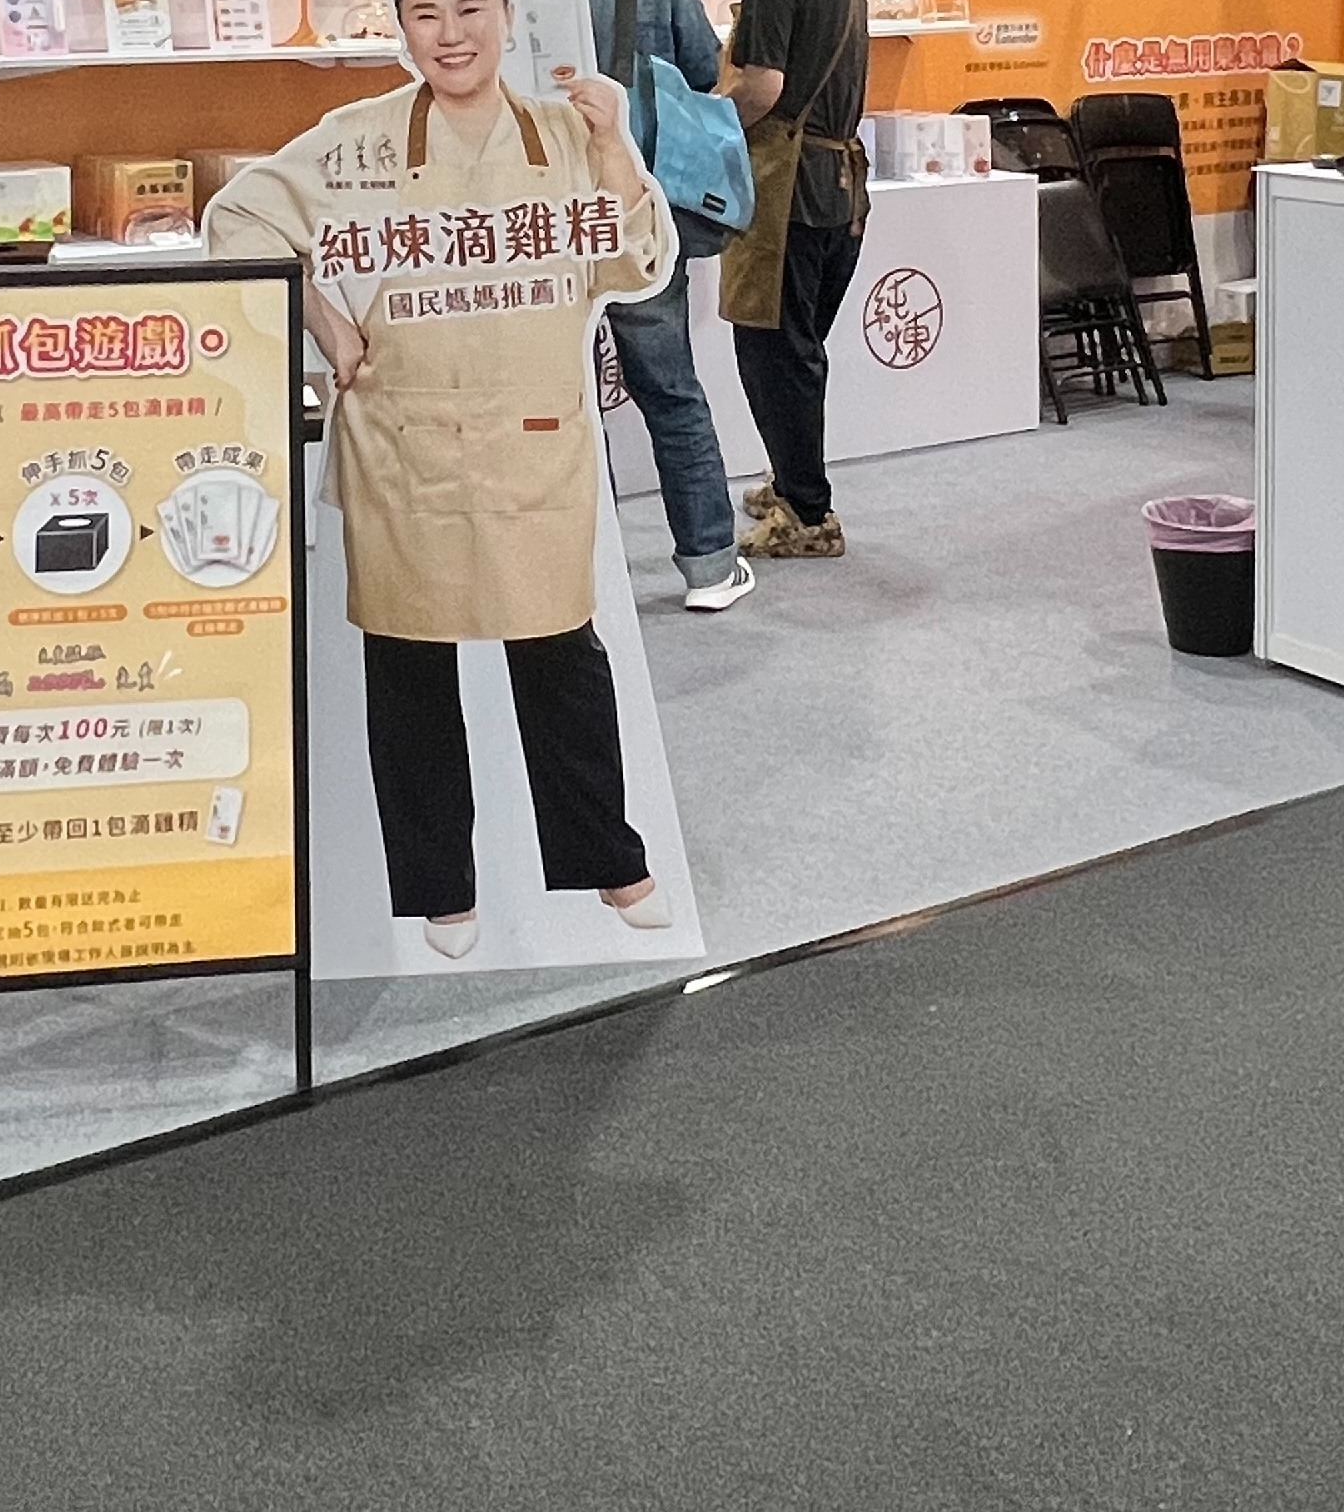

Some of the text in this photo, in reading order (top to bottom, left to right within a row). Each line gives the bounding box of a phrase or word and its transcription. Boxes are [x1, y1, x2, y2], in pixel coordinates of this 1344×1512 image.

[318, 195, 623, 279] 純煉滴雞精
